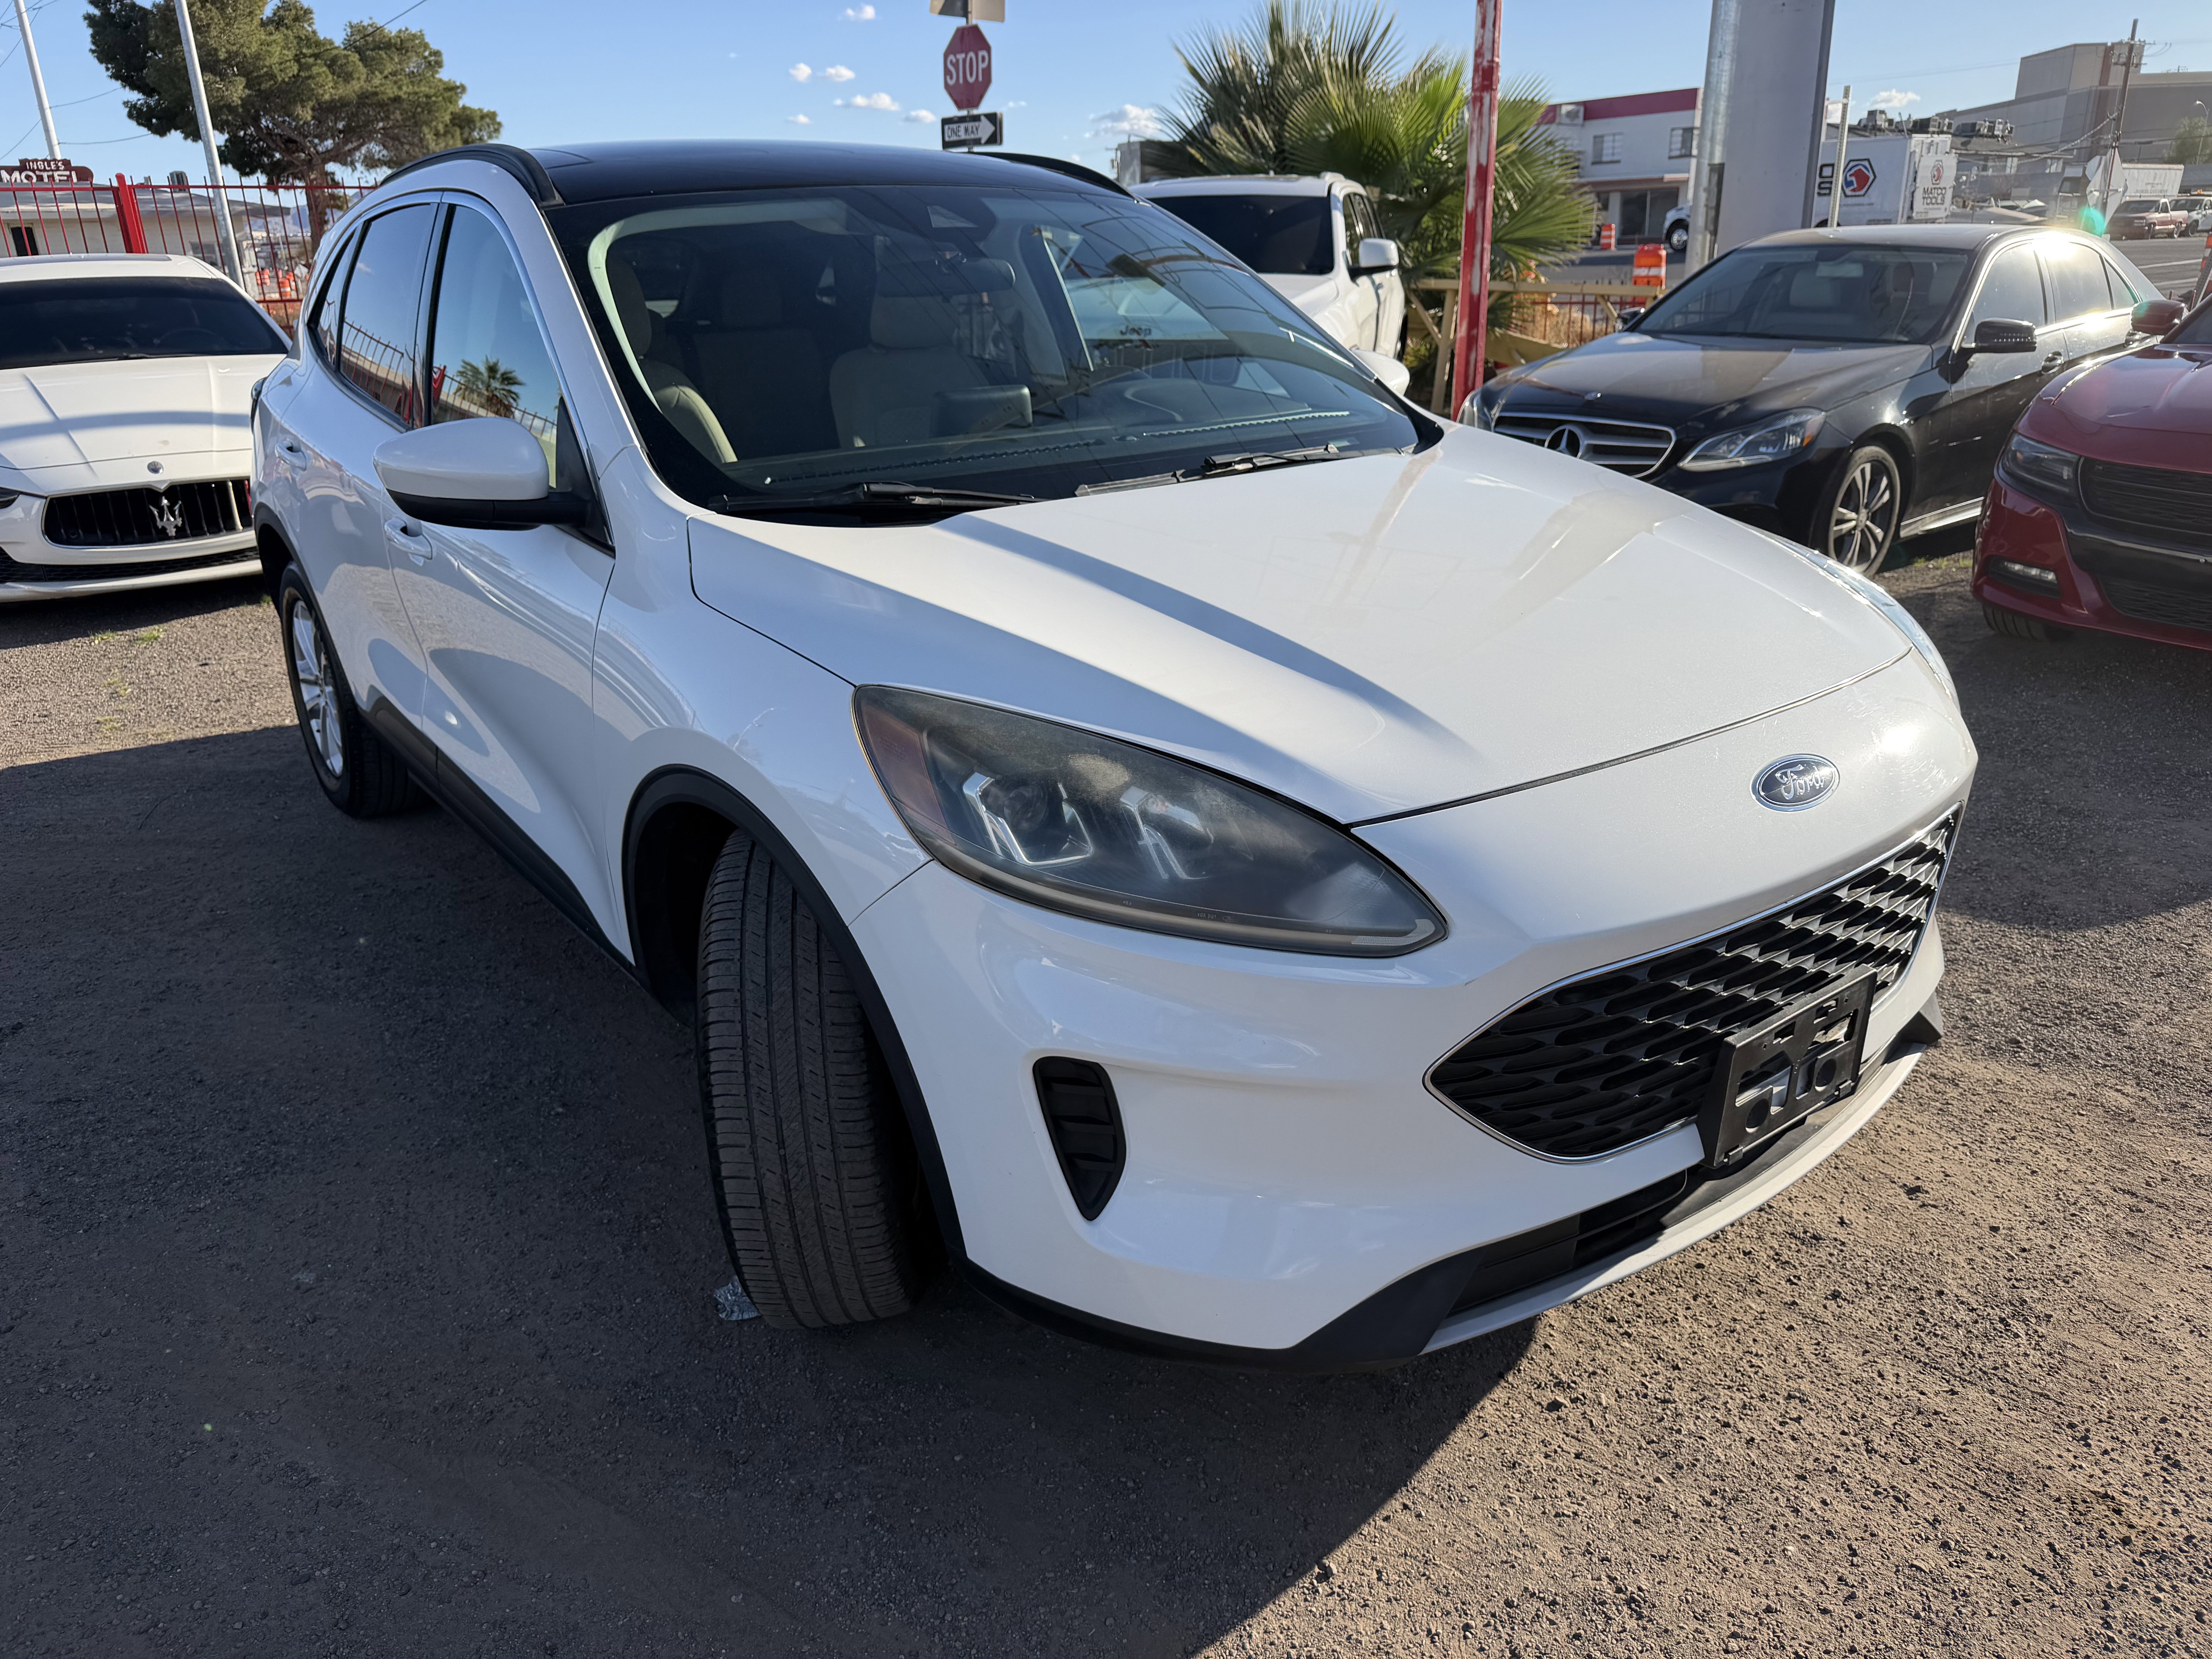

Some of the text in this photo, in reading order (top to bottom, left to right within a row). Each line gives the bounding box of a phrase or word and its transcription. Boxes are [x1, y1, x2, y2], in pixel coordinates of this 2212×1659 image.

[946, 50, 989, 86] STOP
[947, 124, 980, 138] ONE WAY
[1922, 187, 1946, 197] MATCO
[1922, 194, 1945, 206] TOOLS
[1119, 325, 1151, 337] Jeep
[1775, 764, 1825, 800] Ford
